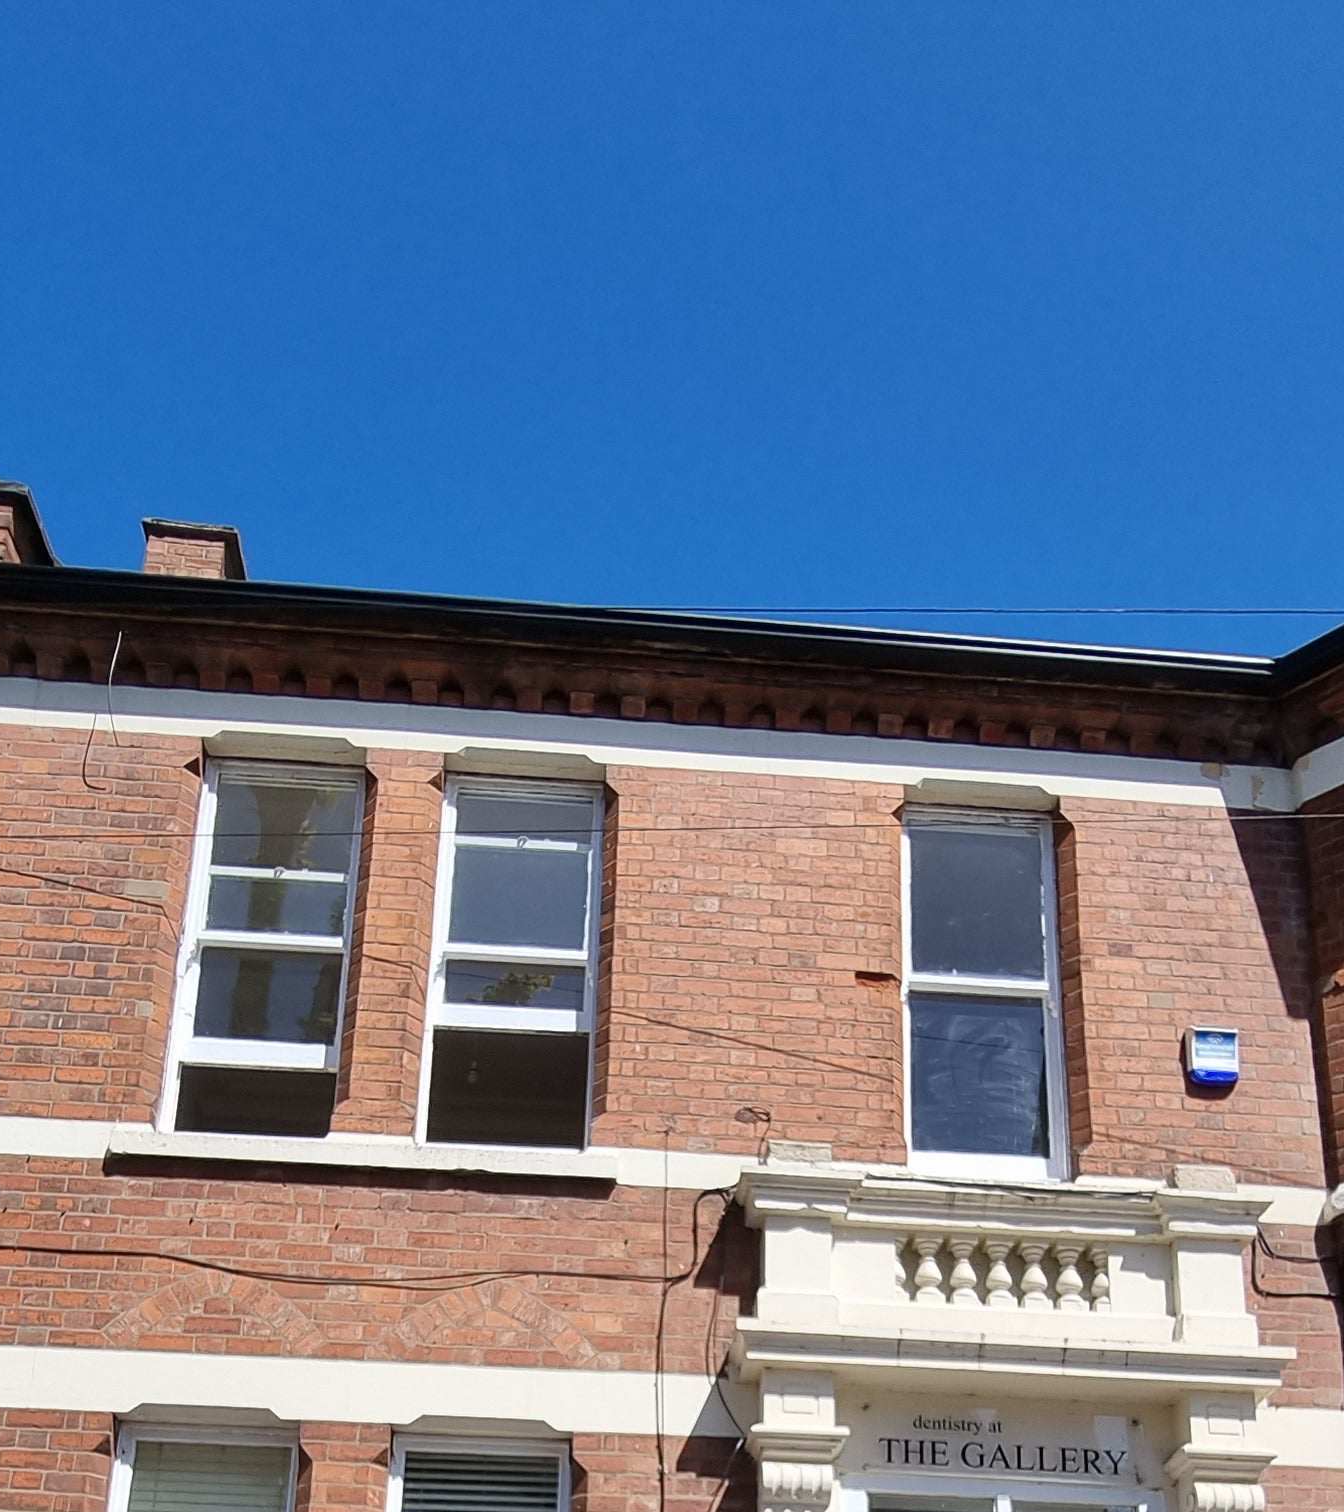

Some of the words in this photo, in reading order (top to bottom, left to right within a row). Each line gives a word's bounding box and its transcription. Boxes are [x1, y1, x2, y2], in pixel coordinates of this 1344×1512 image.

[912, 1414, 983, 1436] dentistry
[987, 1420, 1003, 1433] at
[878, 1437, 950, 1467] THE
[960, 1441, 1128, 1476] GALLERY
